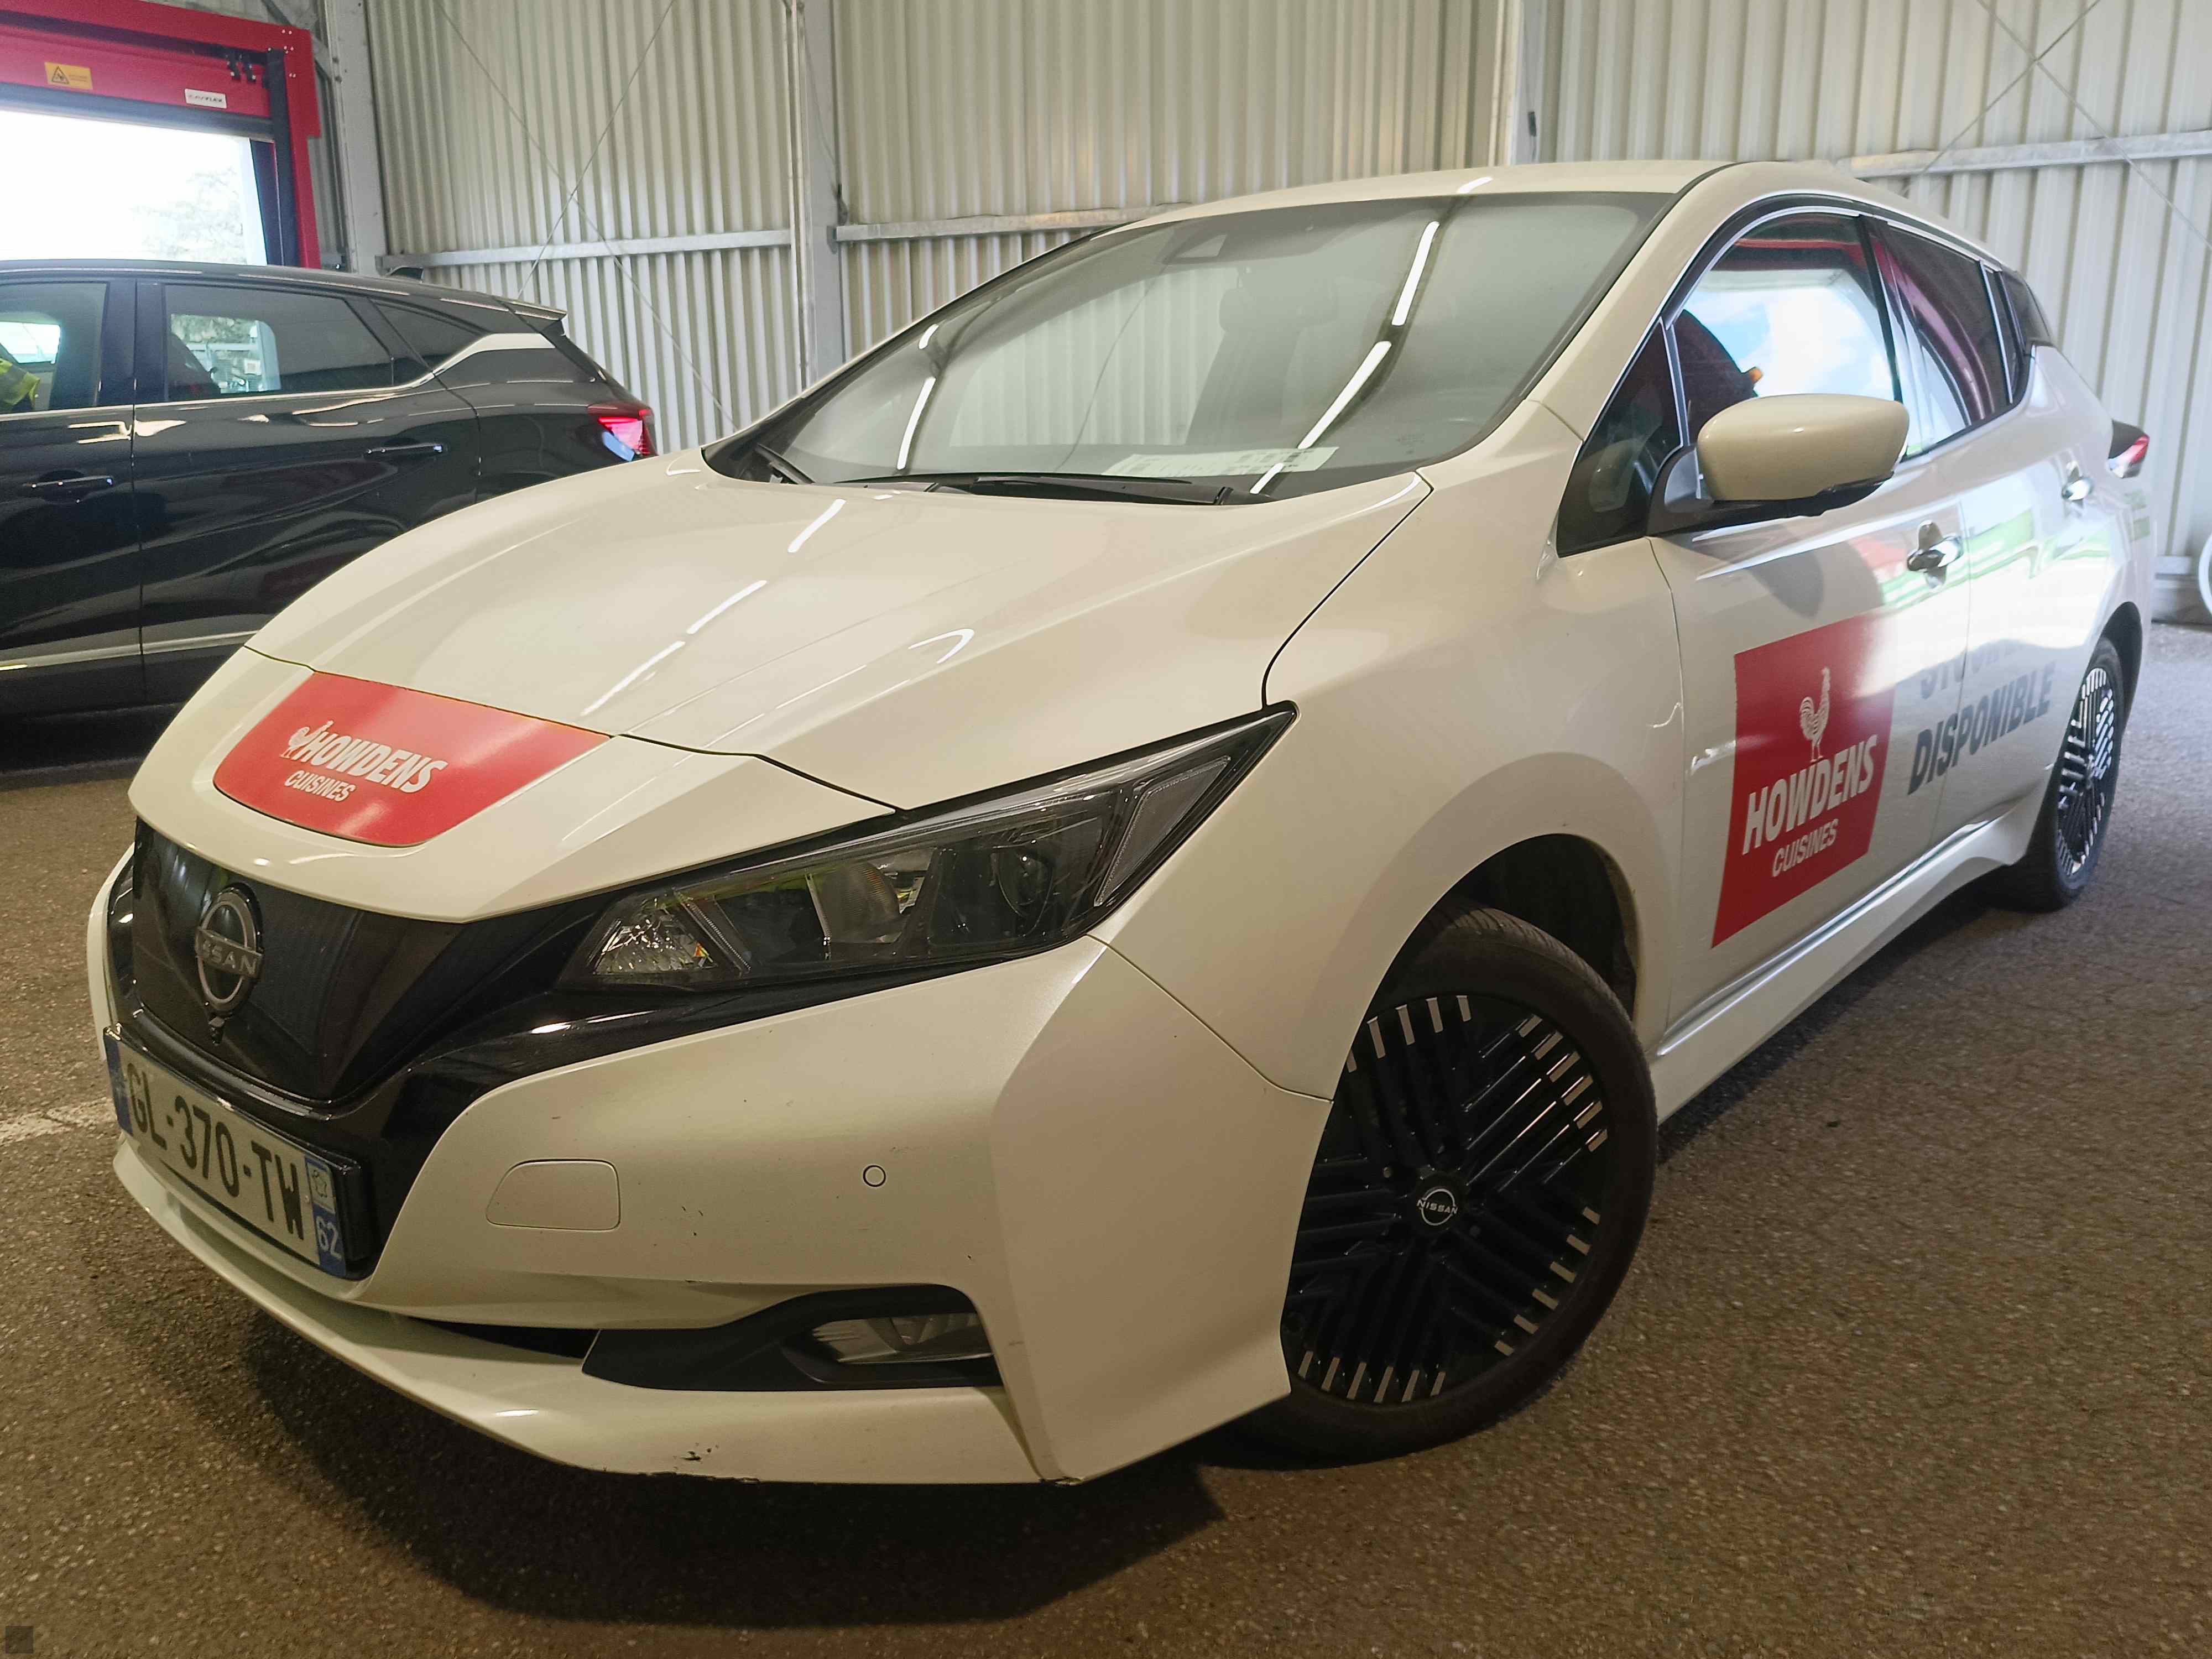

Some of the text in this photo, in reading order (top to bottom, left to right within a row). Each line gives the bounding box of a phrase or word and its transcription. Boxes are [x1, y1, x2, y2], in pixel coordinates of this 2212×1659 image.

[1907, 661, 2056, 795] DISPONIBLE
[284, 770, 357, 802] CUISINES
[291, 731, 448, 793] HOWDENS
[1742, 734, 1877, 855] HOWDENS
[1772, 818, 1839, 877] CUISINES
[127, 1062, 304, 1241] GL-370-TW
[1417, 1199, 1458, 1215] NISSAN
[317, 1216, 342, 1261] 62
